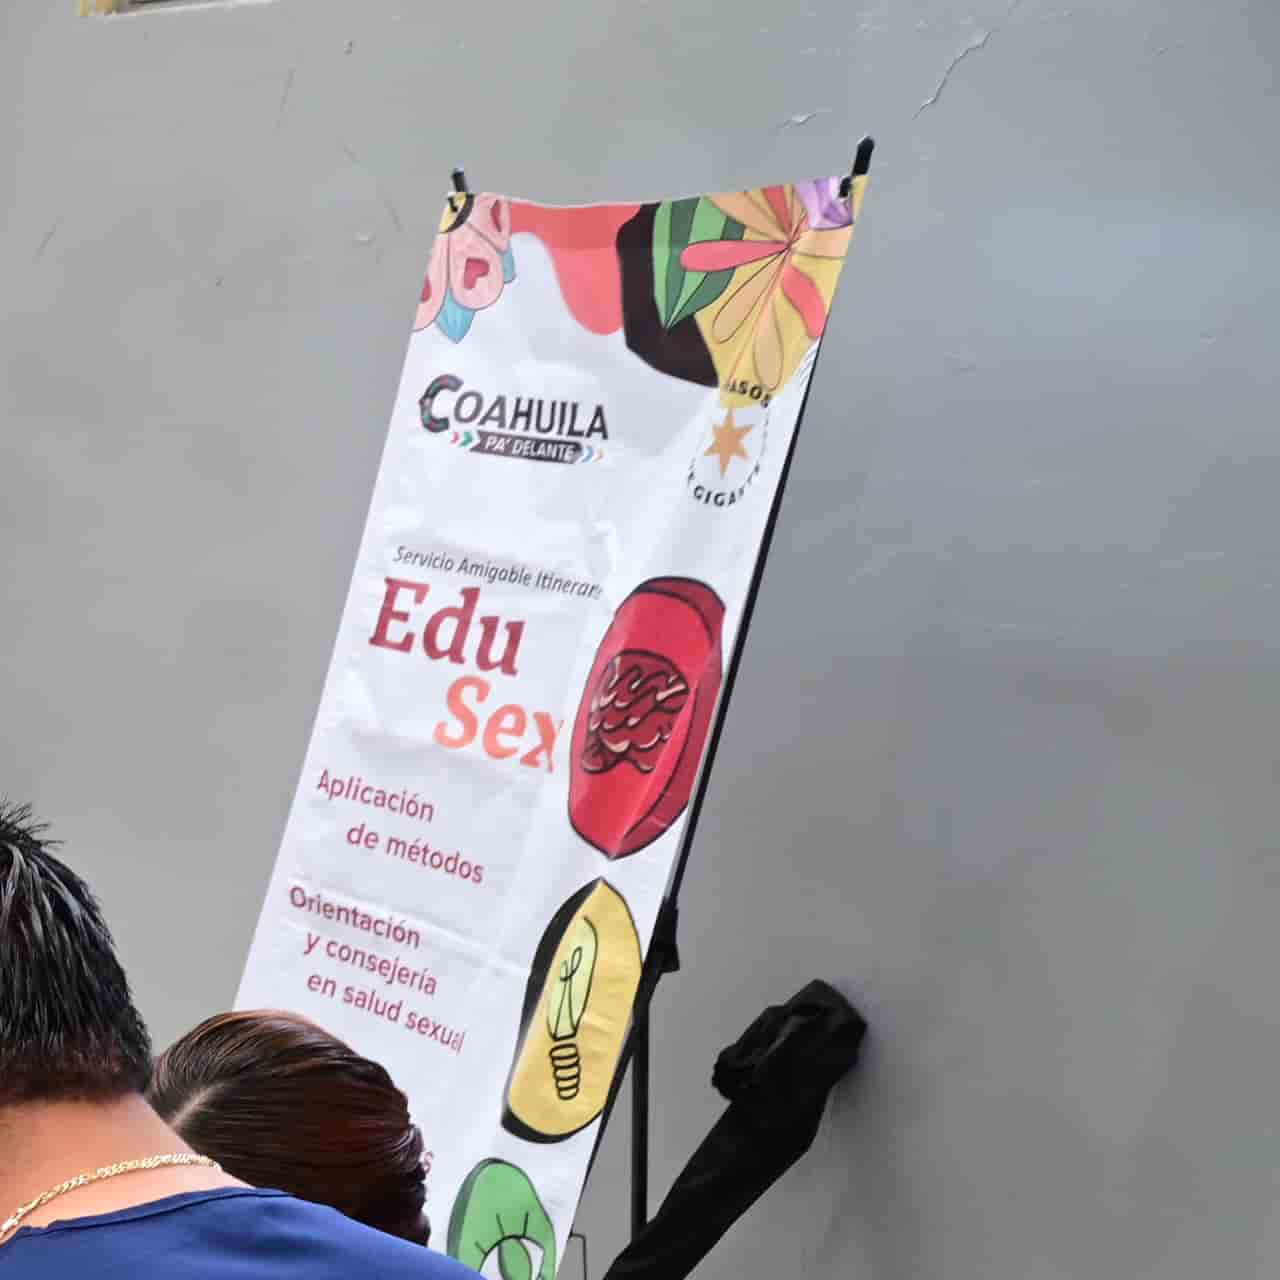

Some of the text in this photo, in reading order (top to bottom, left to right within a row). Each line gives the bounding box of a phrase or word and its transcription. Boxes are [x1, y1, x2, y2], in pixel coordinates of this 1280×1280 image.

[419, 374, 609, 440] COAHUILA
[484, 435, 575, 461] PA' DELANTE
[393, 545, 454, 572] Servicio
[457, 557, 532, 585] Amigable
[368, 576, 527, 677] Edu
[431, 674, 565, 774] Sex
[317, 768, 435, 823] Aplicación
[346, 822, 484, 884] de métodos
[289, 885, 421, 949] Orientación
[303, 931, 438, 997] y consejería
[307, 973, 466, 1053] en salud sexual
